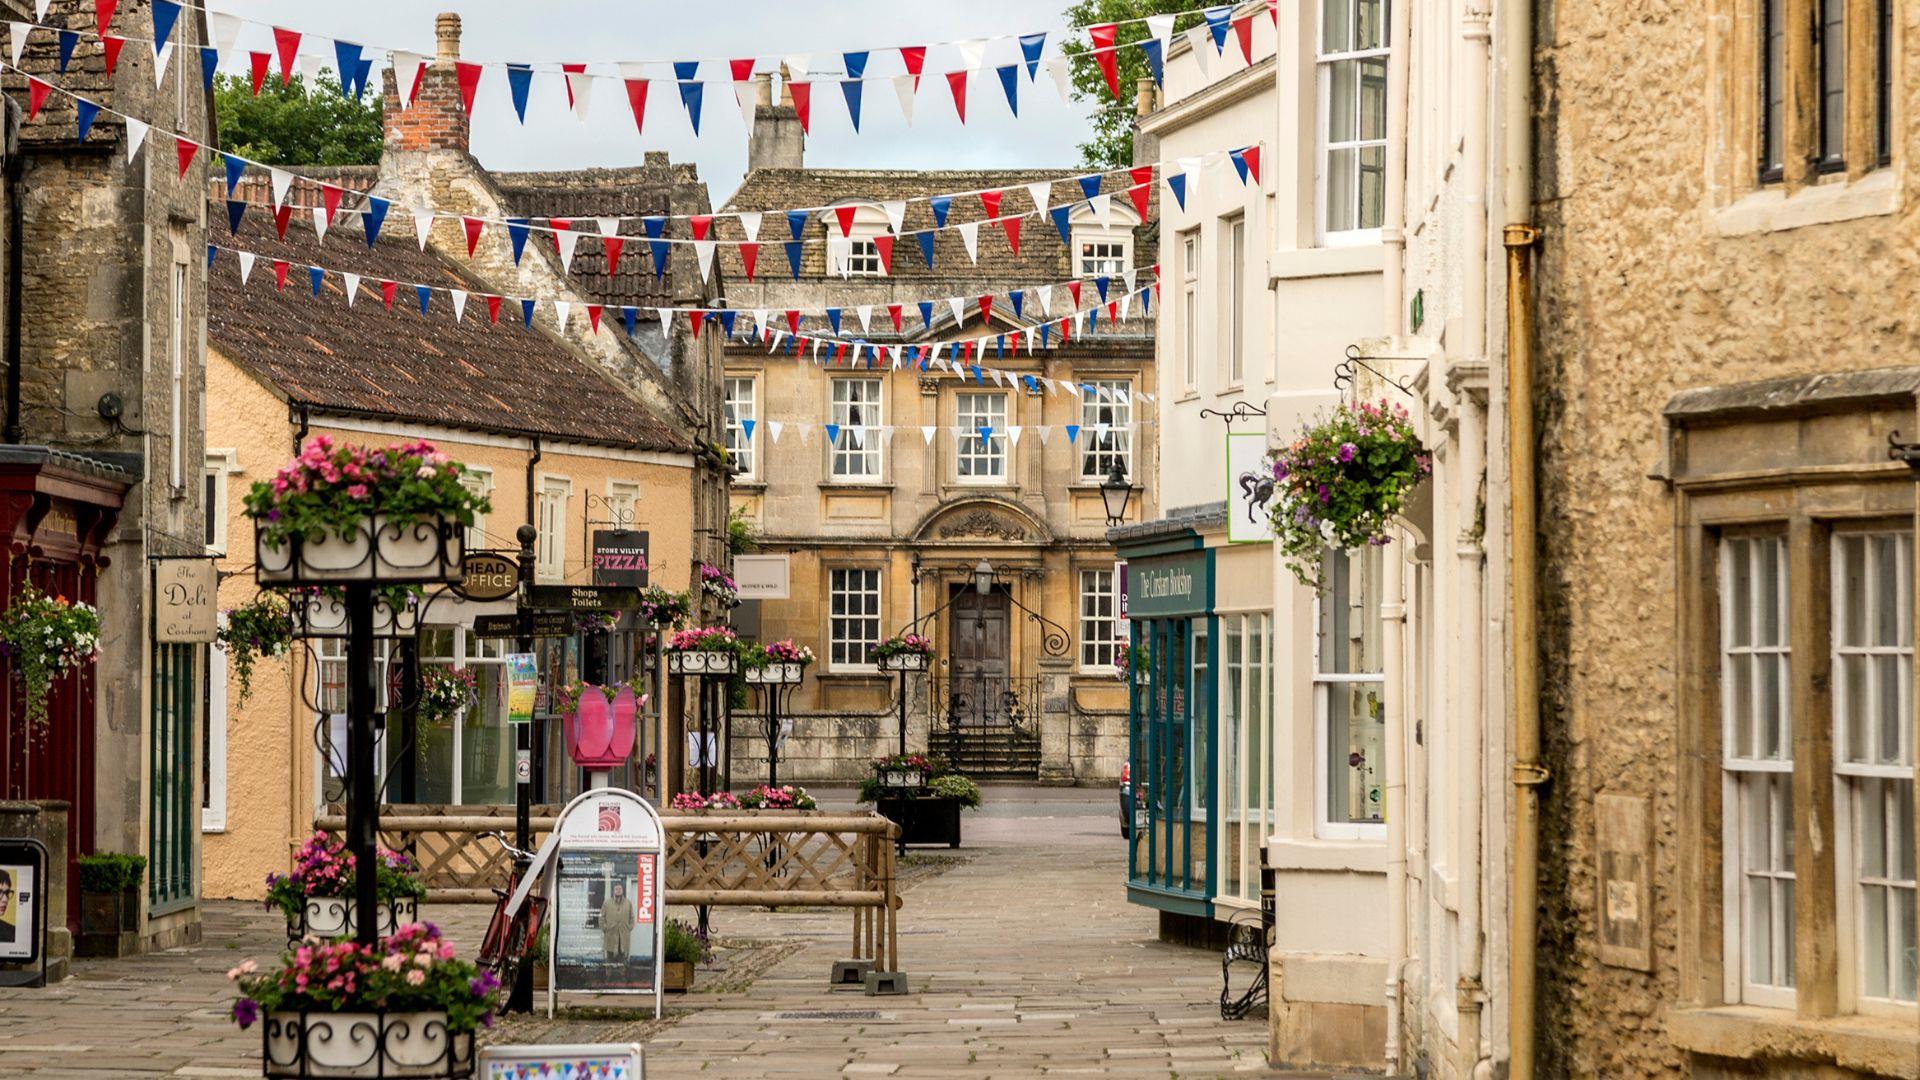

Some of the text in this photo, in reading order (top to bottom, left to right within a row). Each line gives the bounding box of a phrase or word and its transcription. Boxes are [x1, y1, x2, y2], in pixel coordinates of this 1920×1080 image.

[620, 547, 645, 555] WILLY'S
[464, 562, 506, 574] HEAD
[593, 554, 648, 570] PIZZA
[176, 565, 196, 578] The
[1140, 567, 1192, 601] The Corsham Bookshop
[163, 582, 207, 606] Deli
[571, 588, 598, 598] Shops
[571, 598, 602, 607] Toilets
[182, 611, 192, 620] at
[166, 623, 207, 636] Corsham
[638, 863, 653, 920] Pound
